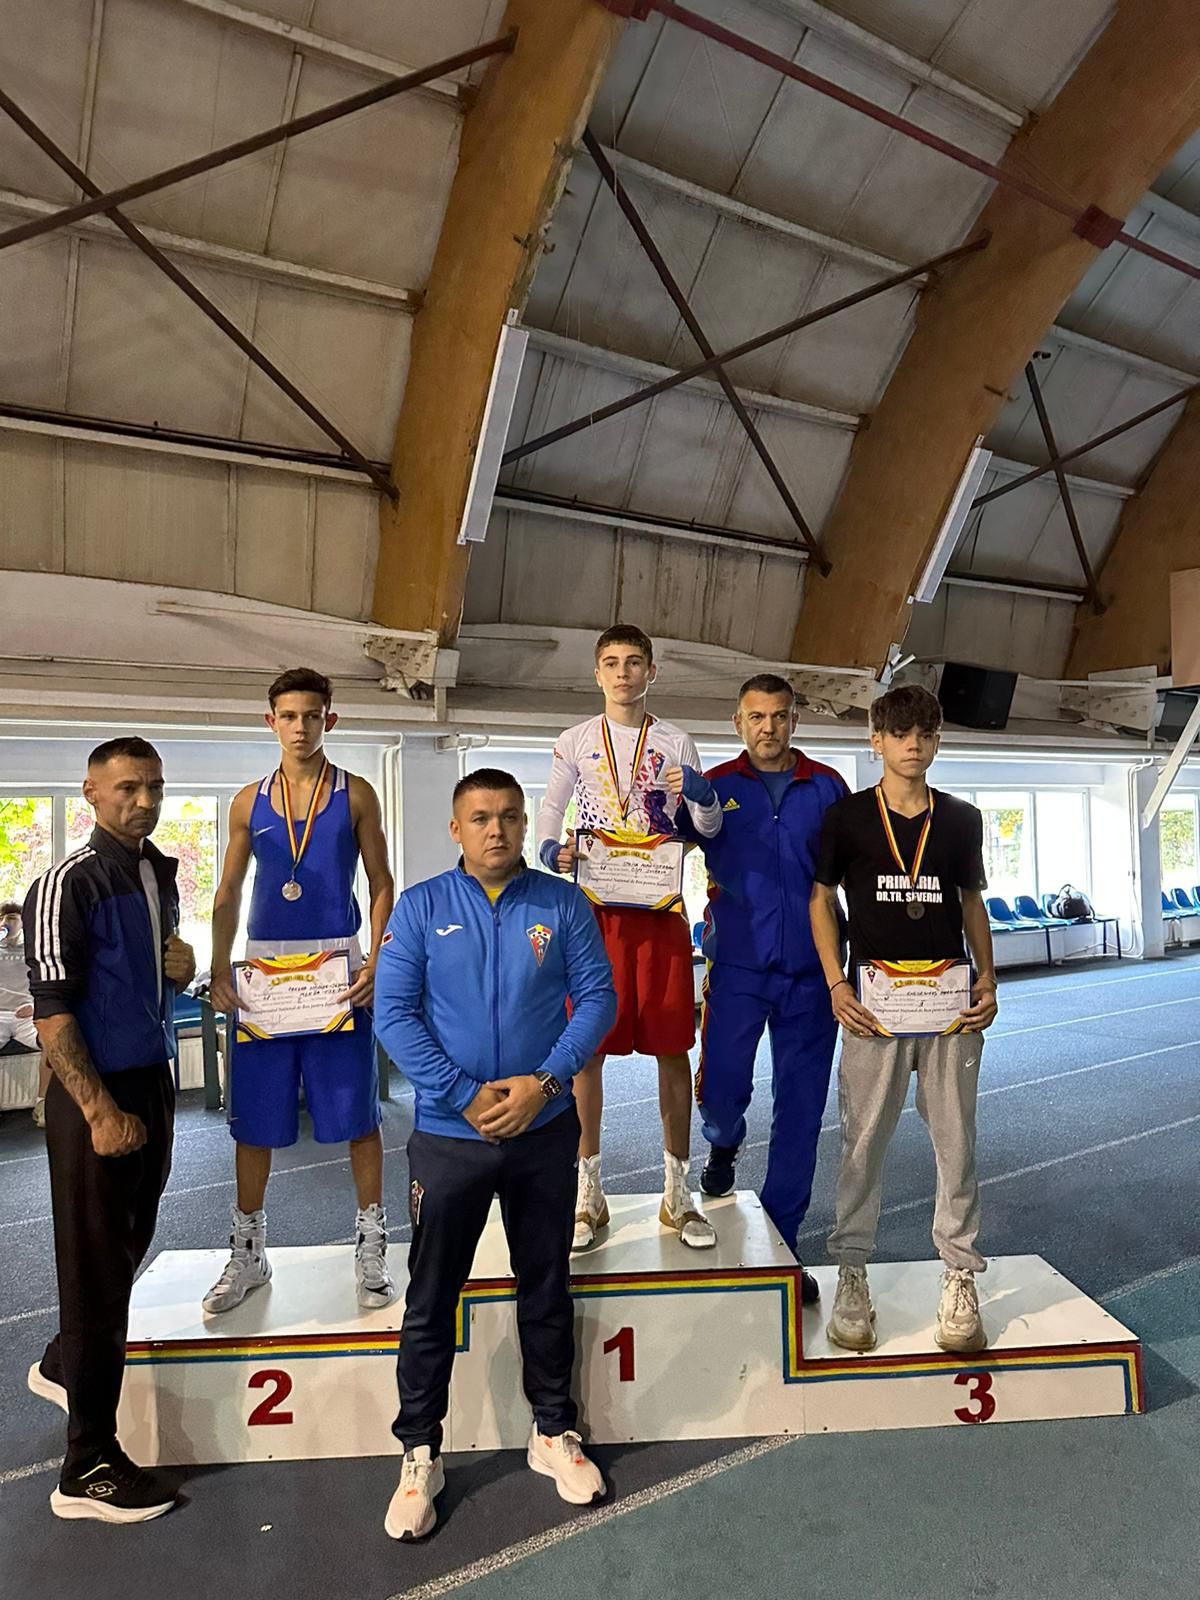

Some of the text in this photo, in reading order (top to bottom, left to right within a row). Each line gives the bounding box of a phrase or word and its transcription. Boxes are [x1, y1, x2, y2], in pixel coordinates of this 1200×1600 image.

[877, 875, 940, 890] PRIMRIA
[603, 1326, 635, 1382] 1
[247, 1369, 294, 1426] 2
[954, 1371, 996, 1424] 3
